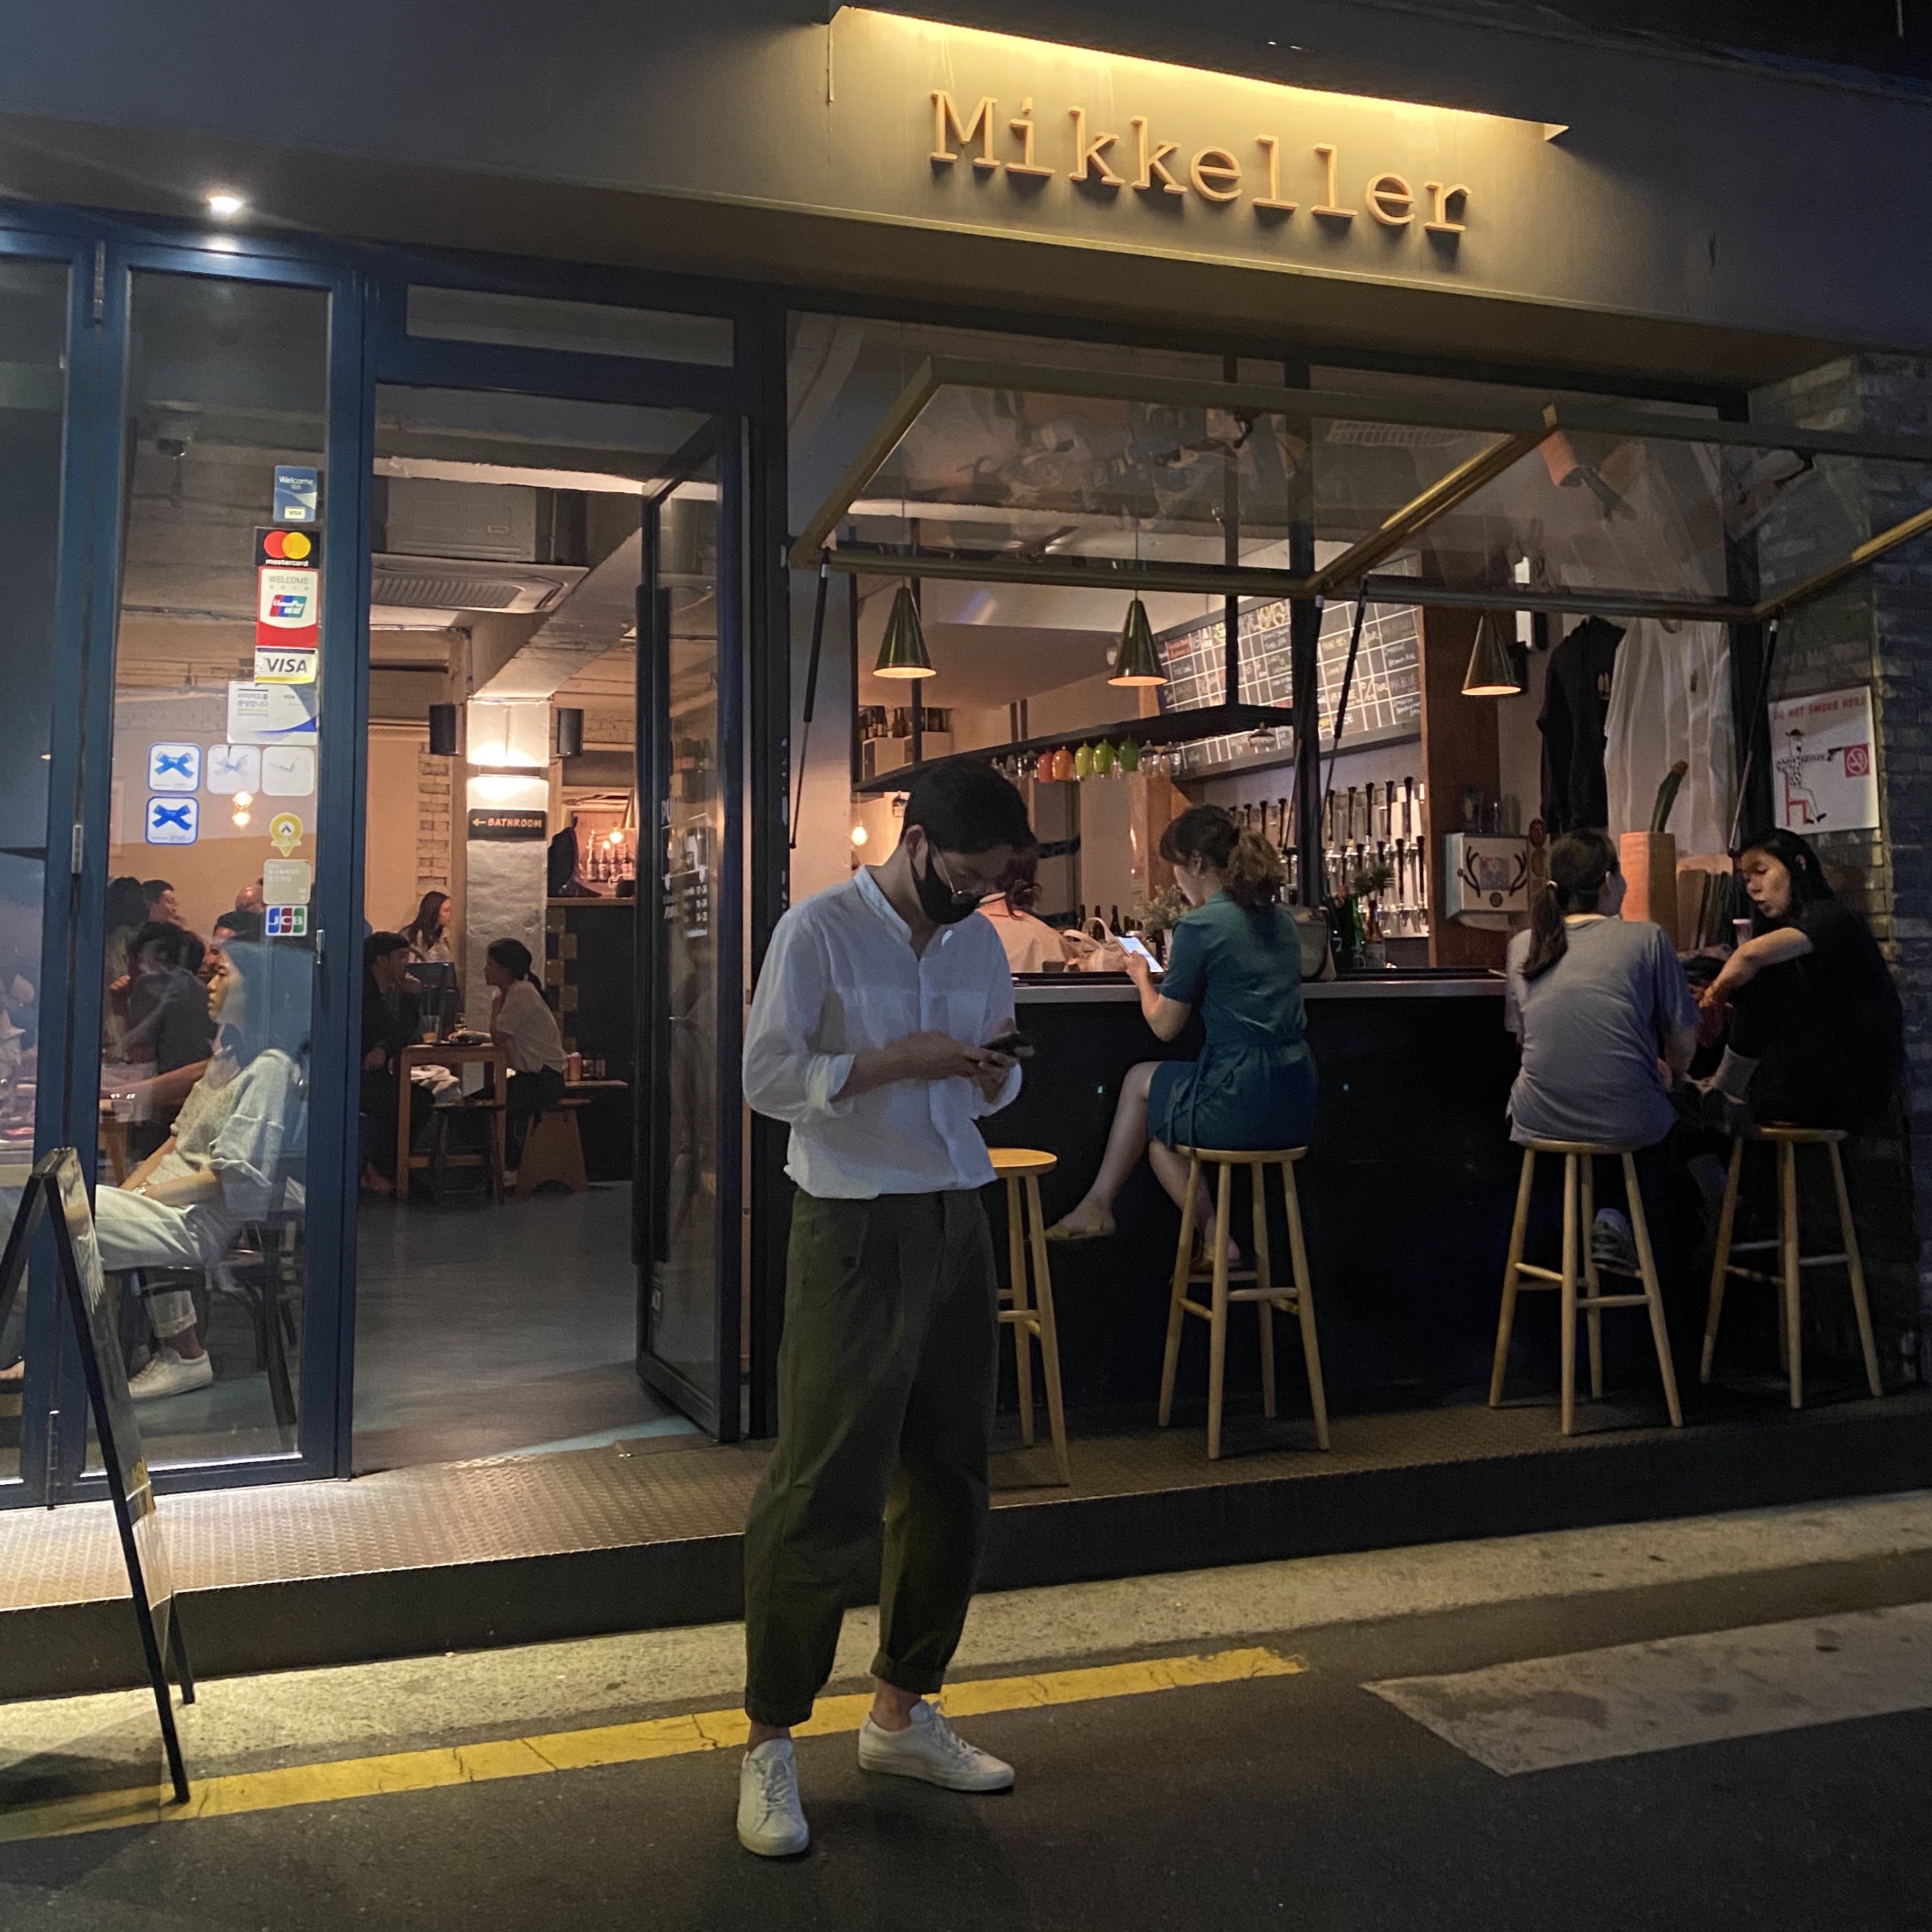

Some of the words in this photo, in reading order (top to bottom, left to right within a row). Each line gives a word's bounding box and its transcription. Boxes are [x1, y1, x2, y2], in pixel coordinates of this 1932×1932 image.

[930, 88, 1471, 232] Mikkeller
[265, 558, 309, 567] mastercard
[268, 575, 309, 585] WELCOME
[263, 658, 308, 673] VISA
[1788, 706, 1805, 717] NOT
[1809, 699, 1839, 714] SMOKE
[1842, 695, 1866, 709] HERE
[487, 818, 542, 828] BATHROOM
